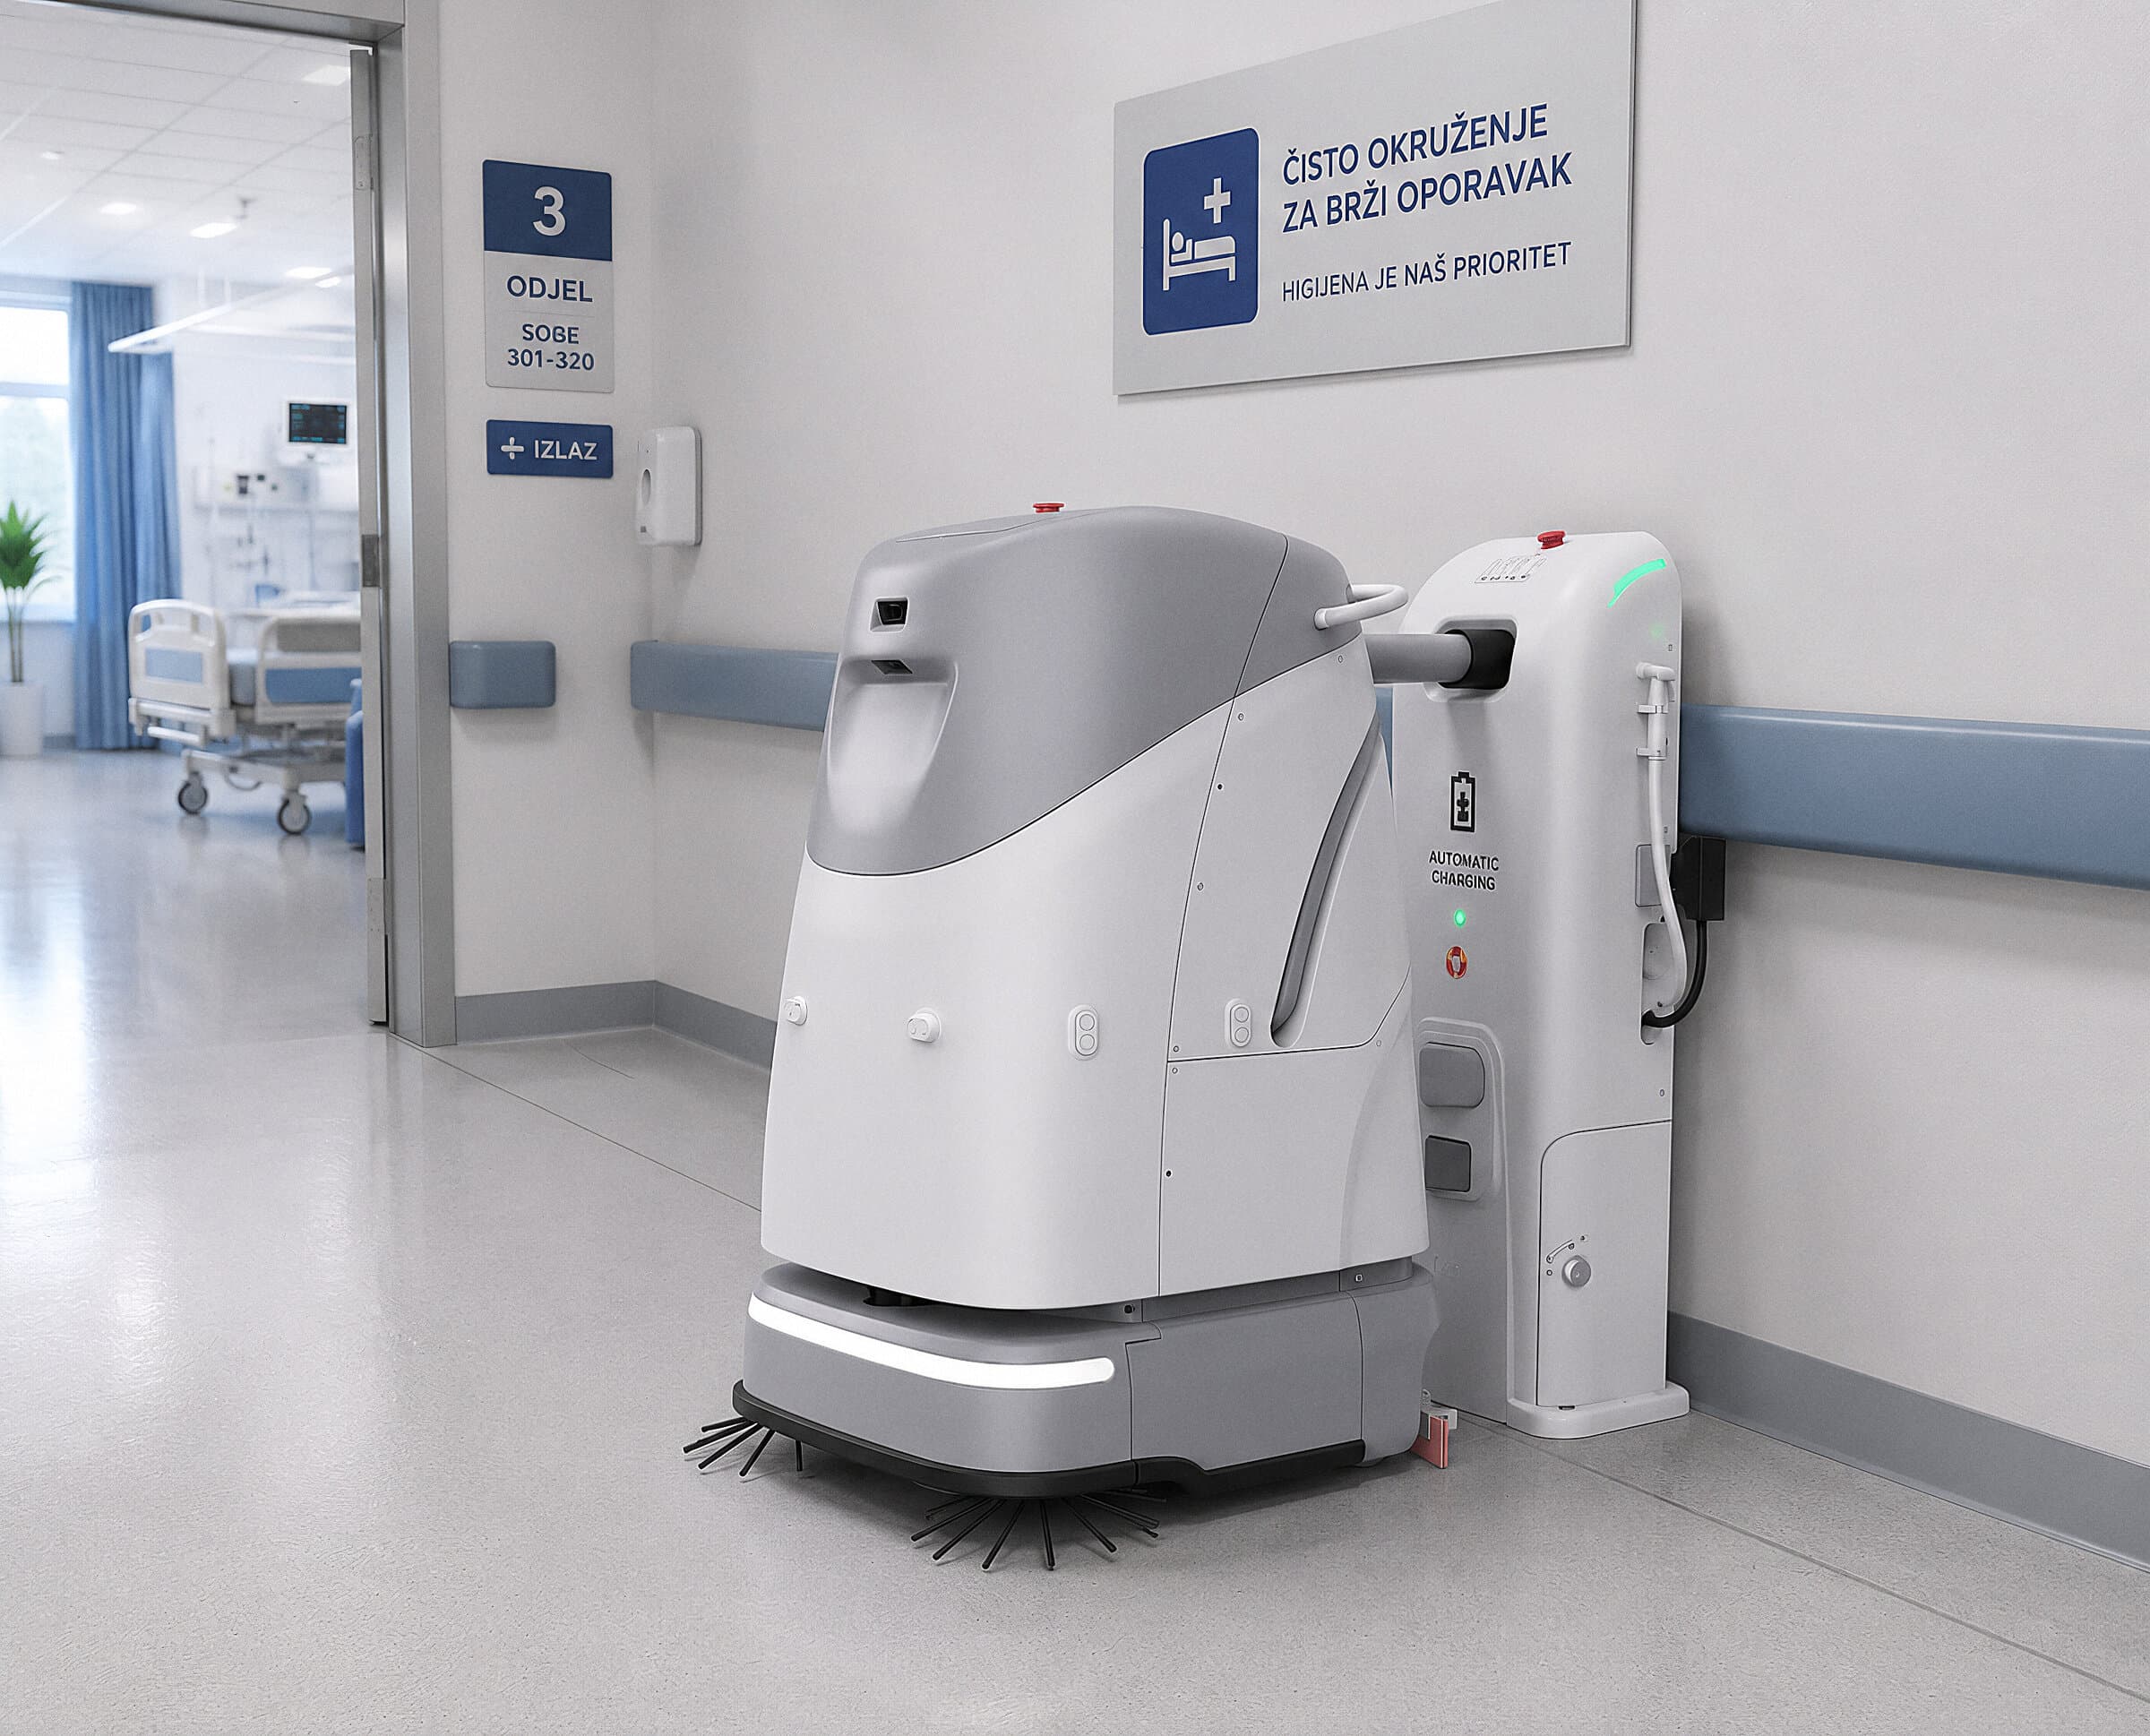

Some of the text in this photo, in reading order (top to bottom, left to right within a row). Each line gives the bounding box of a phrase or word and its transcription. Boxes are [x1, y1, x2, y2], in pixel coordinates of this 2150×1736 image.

[1282, 103, 1548, 185] ČISTO OKRUŽENJE
[1282, 151, 1573, 233] ZA BRŽI OPORAVAK
[532, 185, 566, 236] 3
[1282, 241, 1572, 303] HIGIJENA JE NAŠ PRIORITET
[506, 275, 594, 303] ODJEL
[507, 348, 595, 371] 301-320
[534, 440, 598, 461] IZLAZ
[1429, 850, 1499, 871] AUTOMATIC
[1432, 870, 1496, 891] CHARGING
